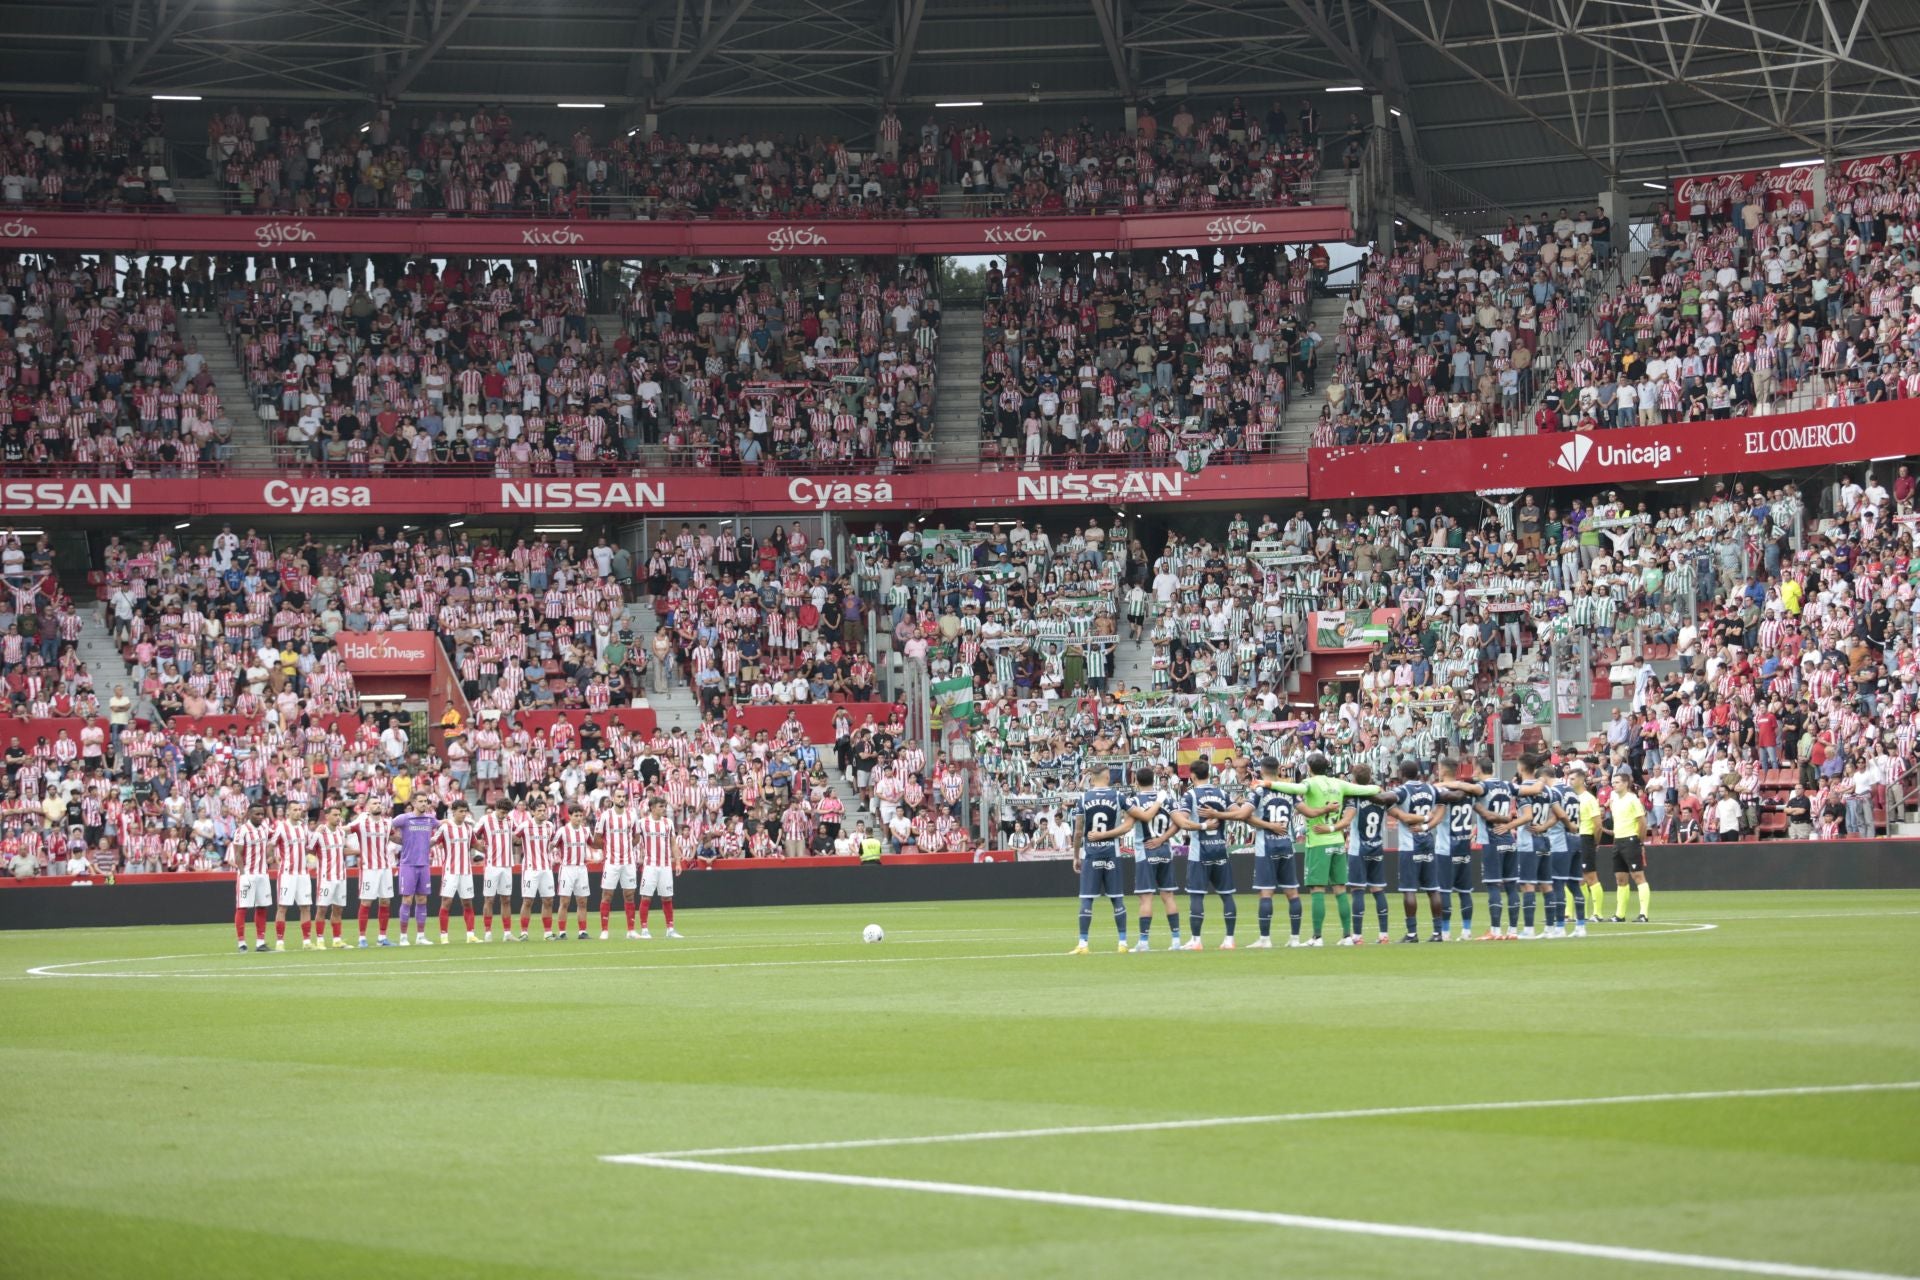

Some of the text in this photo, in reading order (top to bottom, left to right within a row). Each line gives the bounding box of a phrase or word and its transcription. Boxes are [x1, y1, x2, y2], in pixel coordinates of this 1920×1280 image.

[1745, 421, 1856, 454] EL COMERCIO
[1597, 441, 1672, 468] Unicaja
[0, 483, 132, 510] SSAN
[263, 479, 371, 512] Cyasa
[501, 482, 665, 508] NISSAN
[788, 477, 893, 508] Cyasa
[1017, 471, 1182, 501] NISSAN
[1084, 800, 1101, 811] ALEX
[1267, 805, 1289, 827] 16
[1451, 803, 1472, 832] 22
[1092, 812, 1108, 833] 6
[1366, 812, 1379, 839] 8
[362, 881, 370, 891] 15
